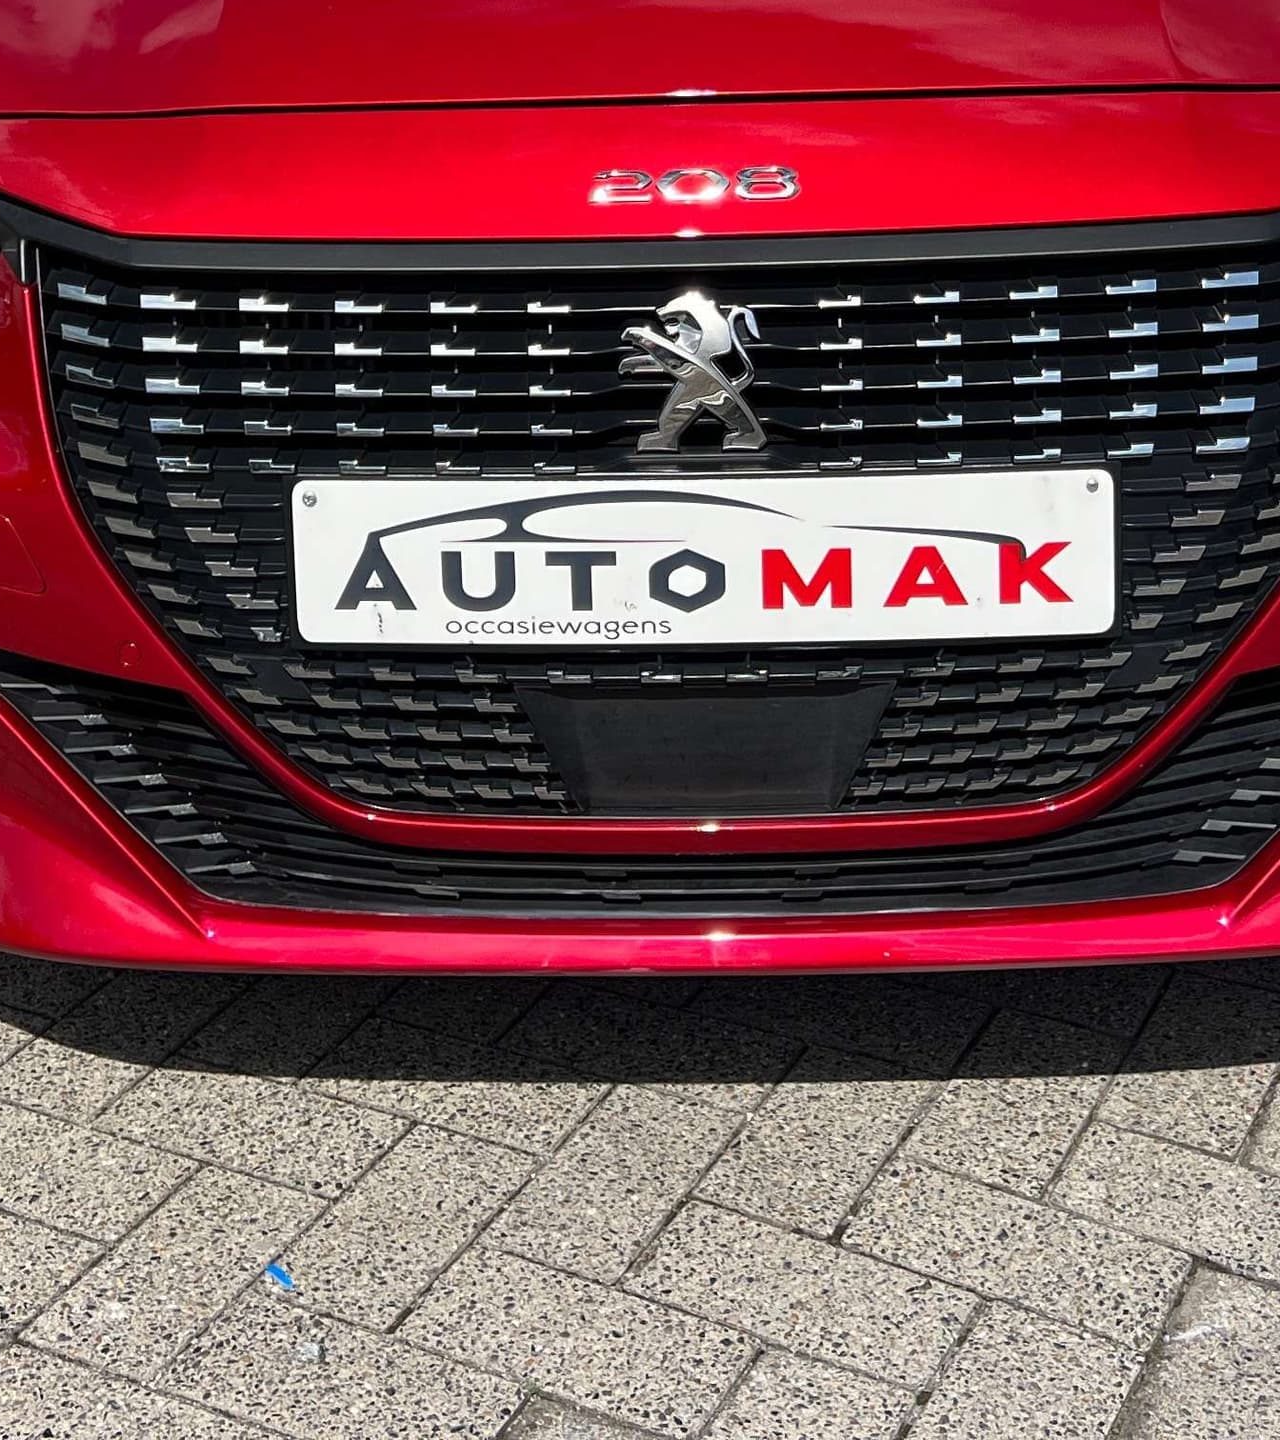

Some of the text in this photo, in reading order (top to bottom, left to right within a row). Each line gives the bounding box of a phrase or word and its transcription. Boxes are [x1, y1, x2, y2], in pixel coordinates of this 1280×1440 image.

[588, 166, 801, 204] 208
[334, 534, 1073, 614] AUTOMAK
[445, 615, 672, 640] occasiewagens
